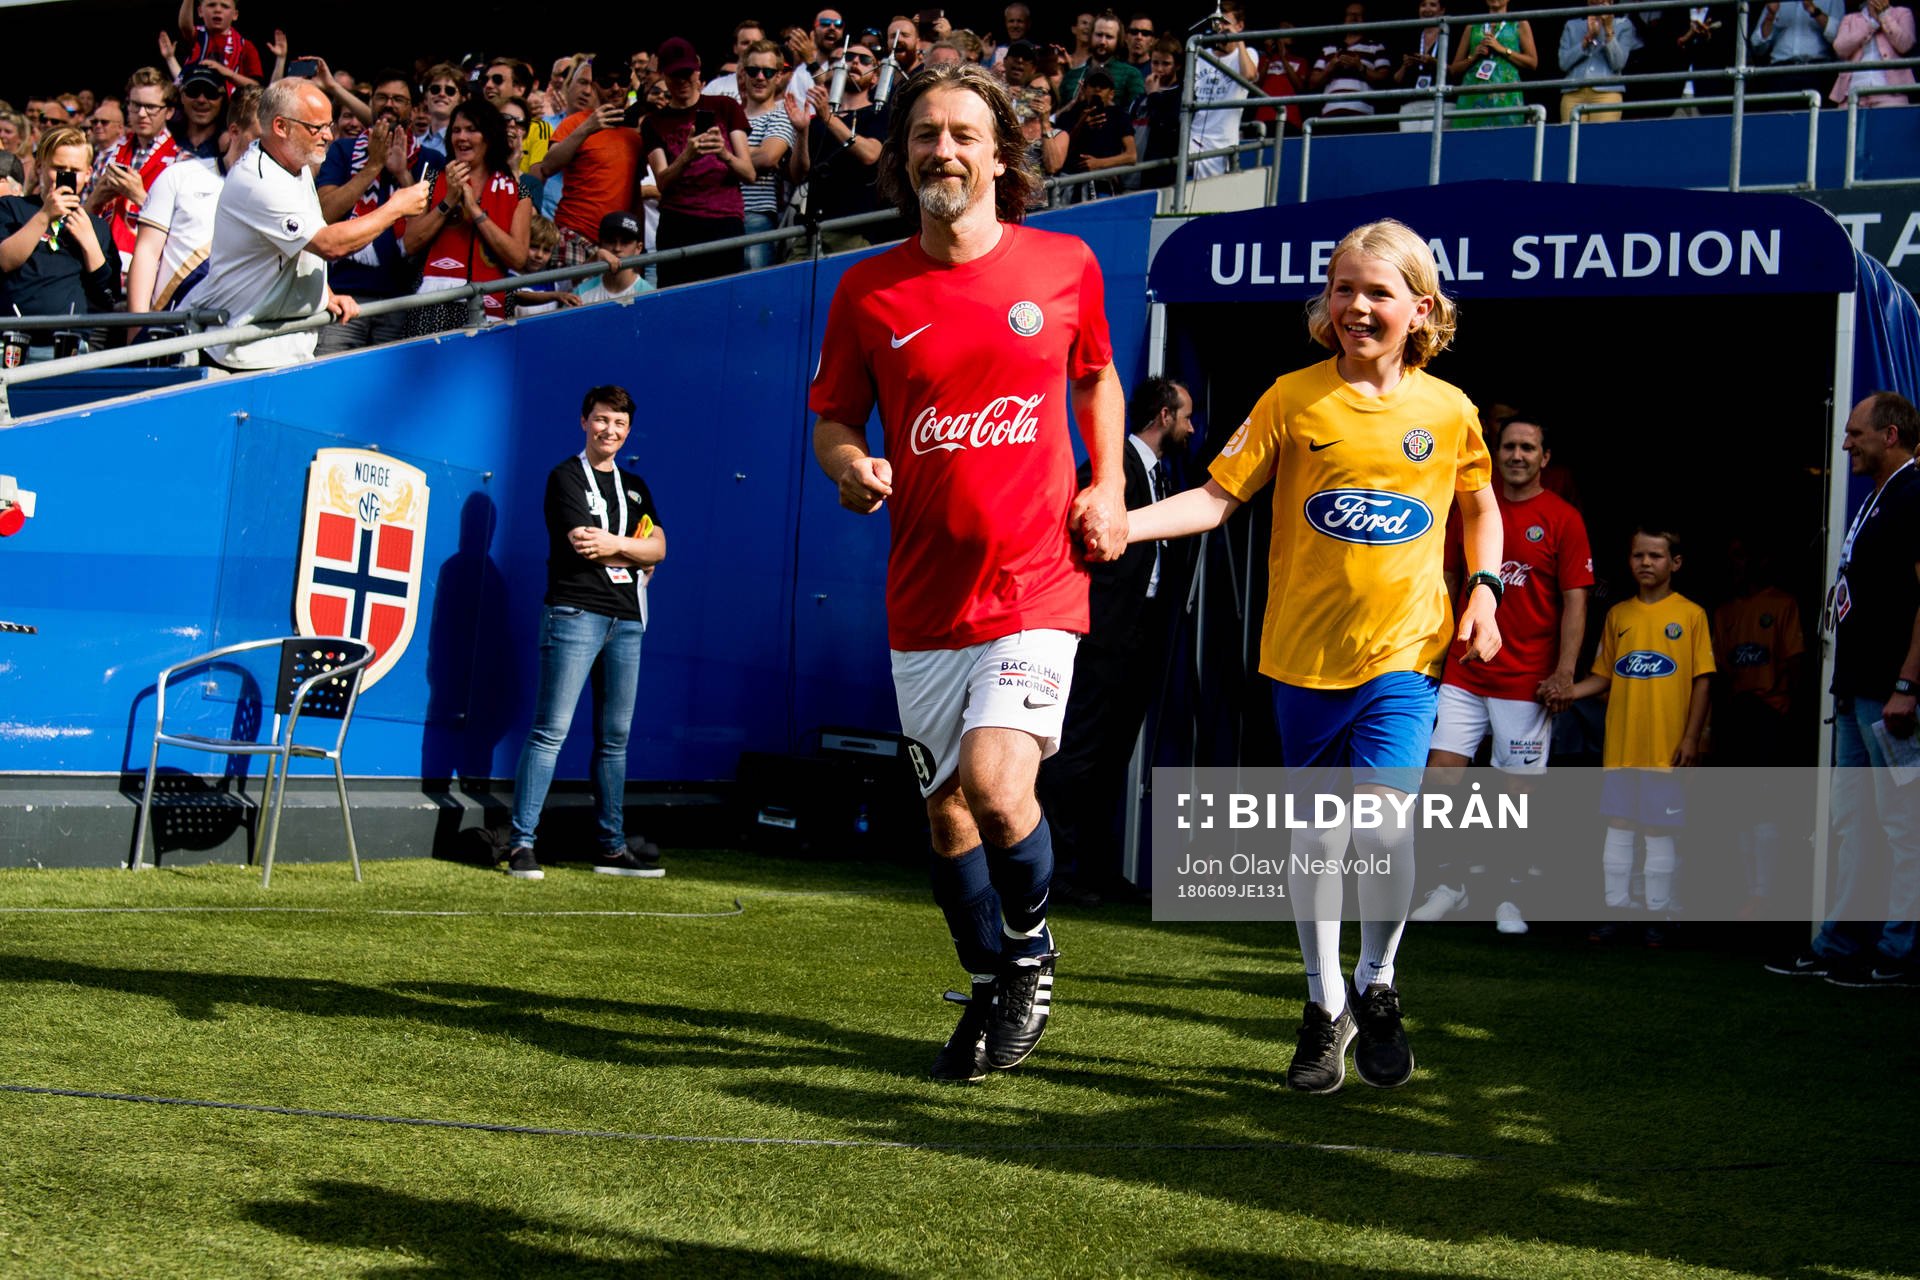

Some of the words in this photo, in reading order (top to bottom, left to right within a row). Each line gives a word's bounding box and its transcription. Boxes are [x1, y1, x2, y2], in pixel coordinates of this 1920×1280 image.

[1512, 229, 1781, 280] STADION
[911, 392, 1046, 456] Coca-Cola
[355, 461, 391, 487] NORGE
[1324, 495, 1413, 534] Ford
[1001, 661, 1062, 684] BACALHAU
[1626, 654, 1663, 673] Ford
[999, 677, 1013, 686] DA
[1016, 679, 1059, 700] NORUEGA
